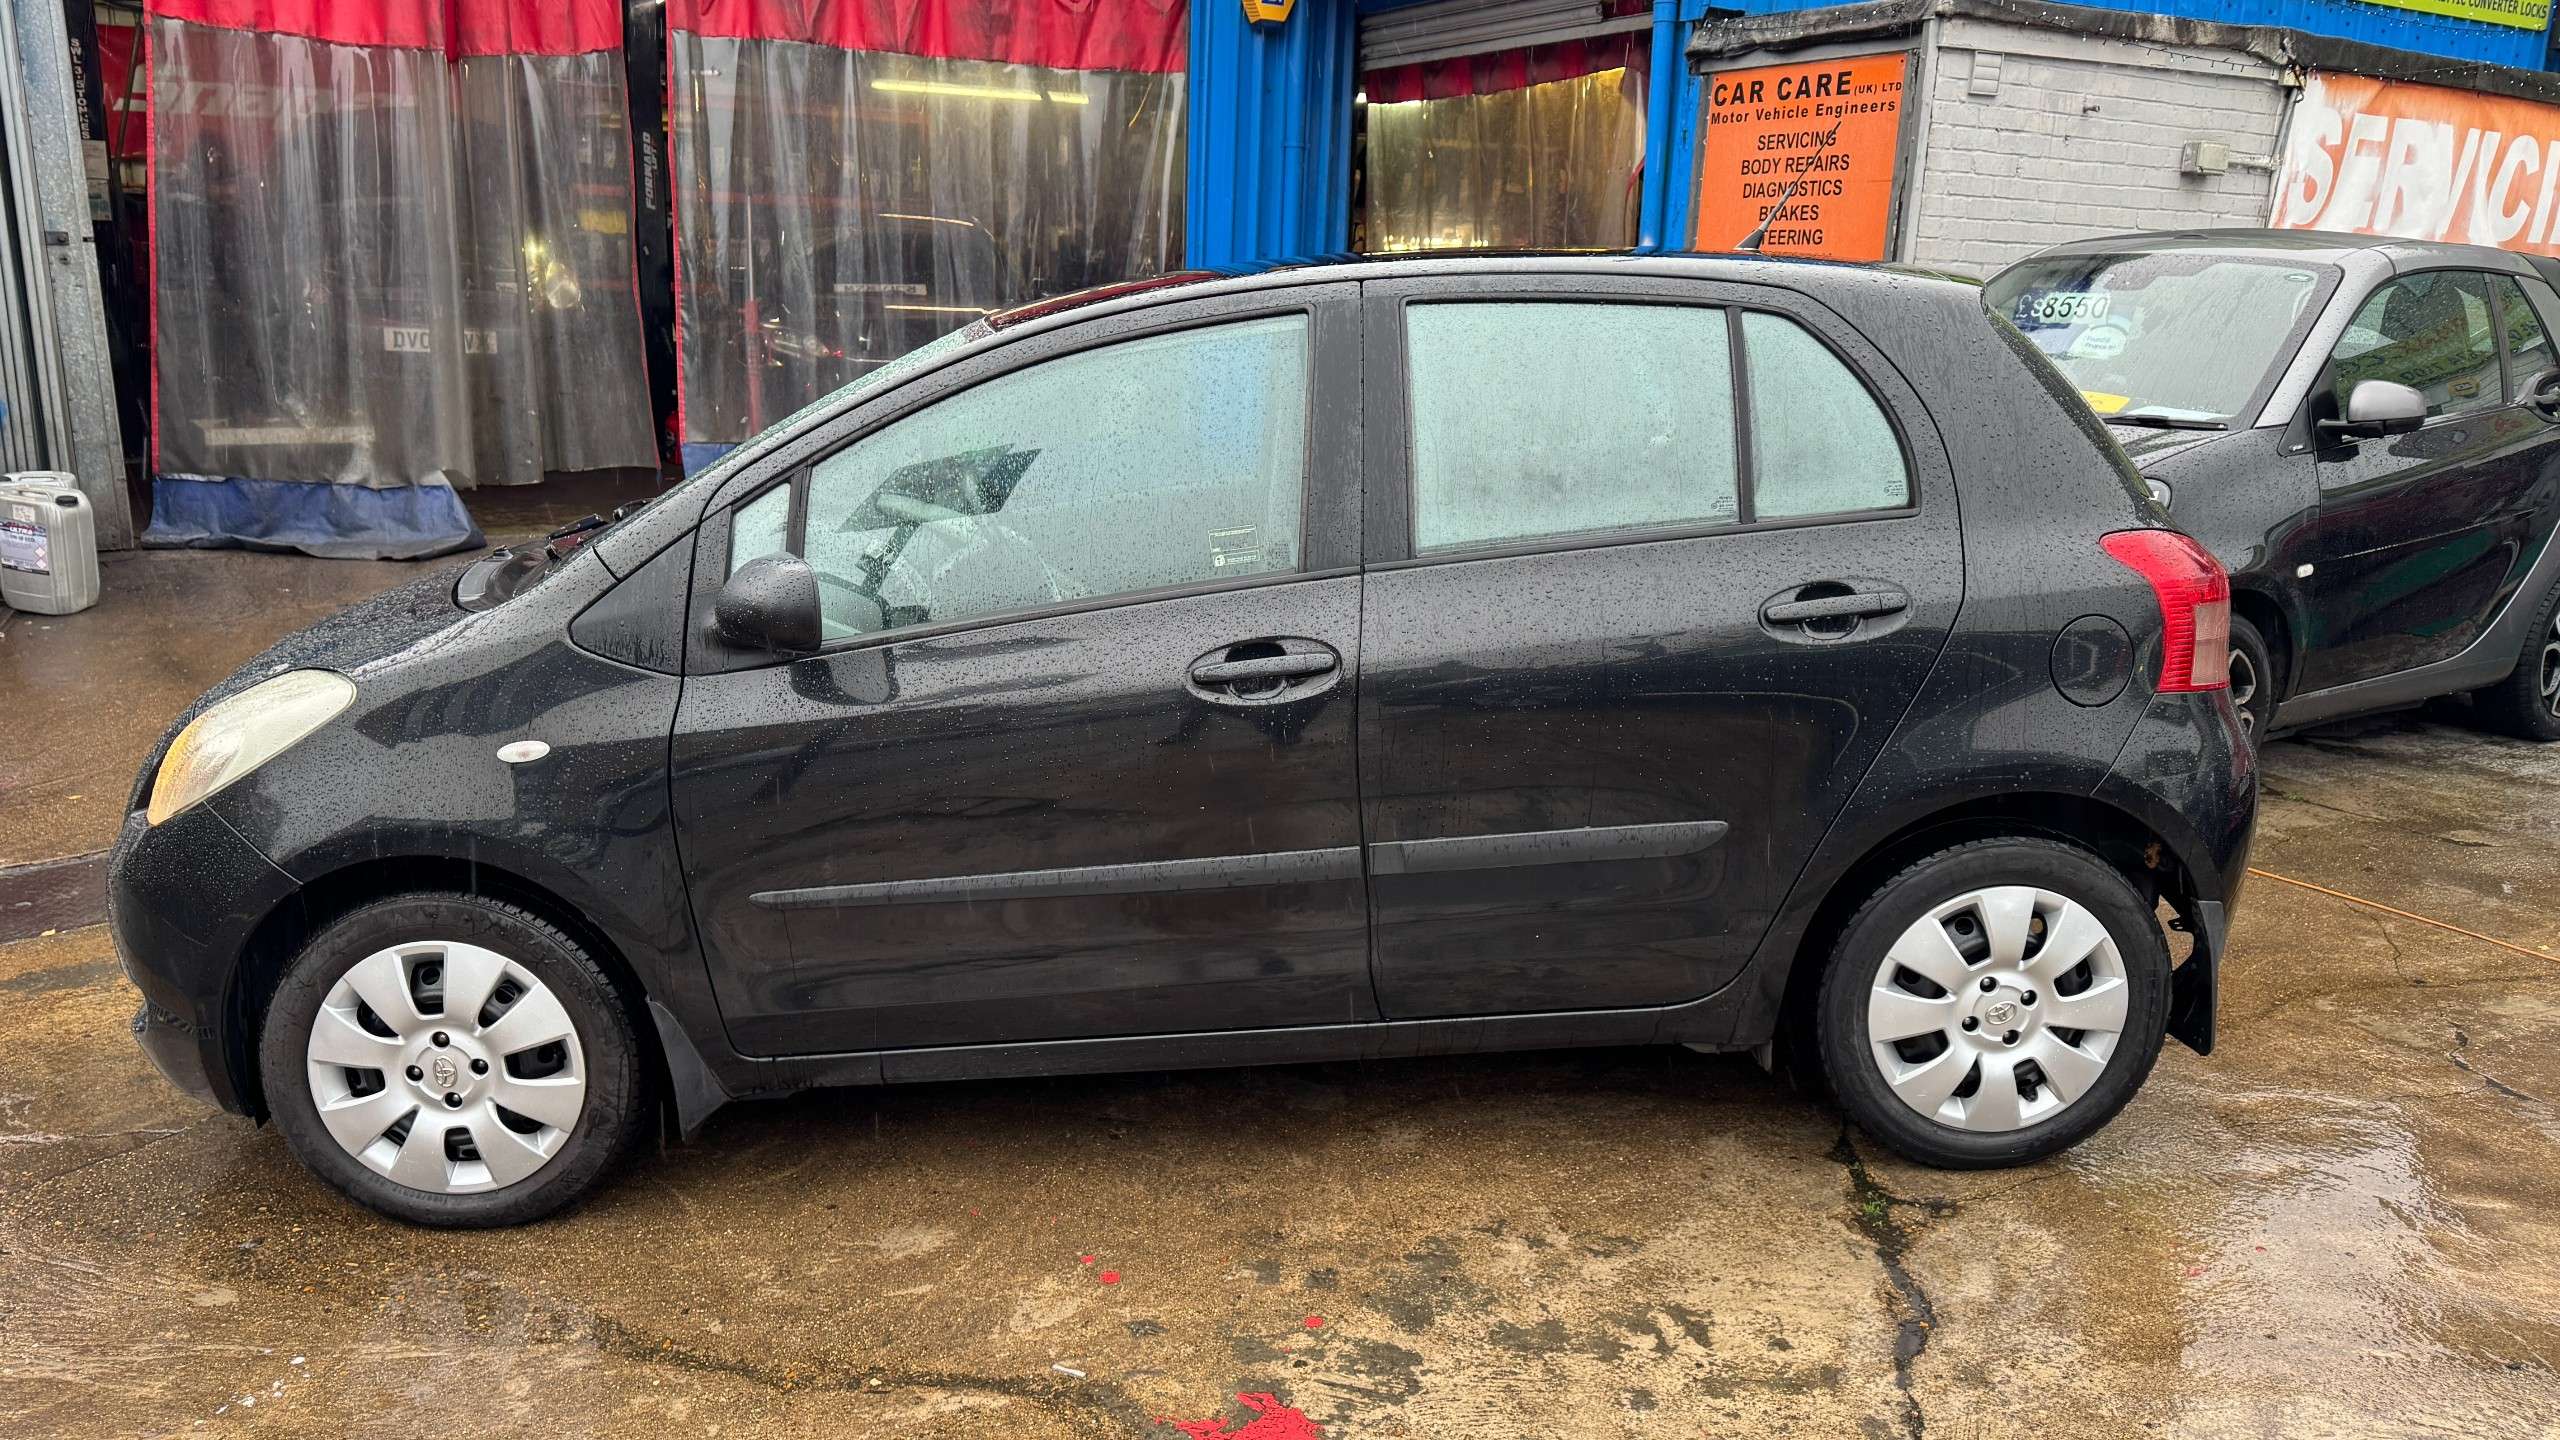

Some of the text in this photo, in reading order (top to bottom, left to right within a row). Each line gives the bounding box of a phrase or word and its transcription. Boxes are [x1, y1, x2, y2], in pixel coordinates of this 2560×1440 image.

[2520, 4, 2548, 19] LOCKS
[1714, 71, 1902, 107] CAR CARE (UK) LTD
[1711, 100, 1896, 125] Motor Vehicle Engineers
[1757, 130, 1837, 151] SERVICING
[643, 131, 657, 210] FORWARD
[1741, 154, 1850, 175] BODY REPAIRS
[2280, 105, 2560, 248] SERVICI
[1743, 179, 1843, 199] DIAGNOSTICS
[1759, 204, 1820, 222] BRAKES
[1761, 229, 1824, 246] TEERING
